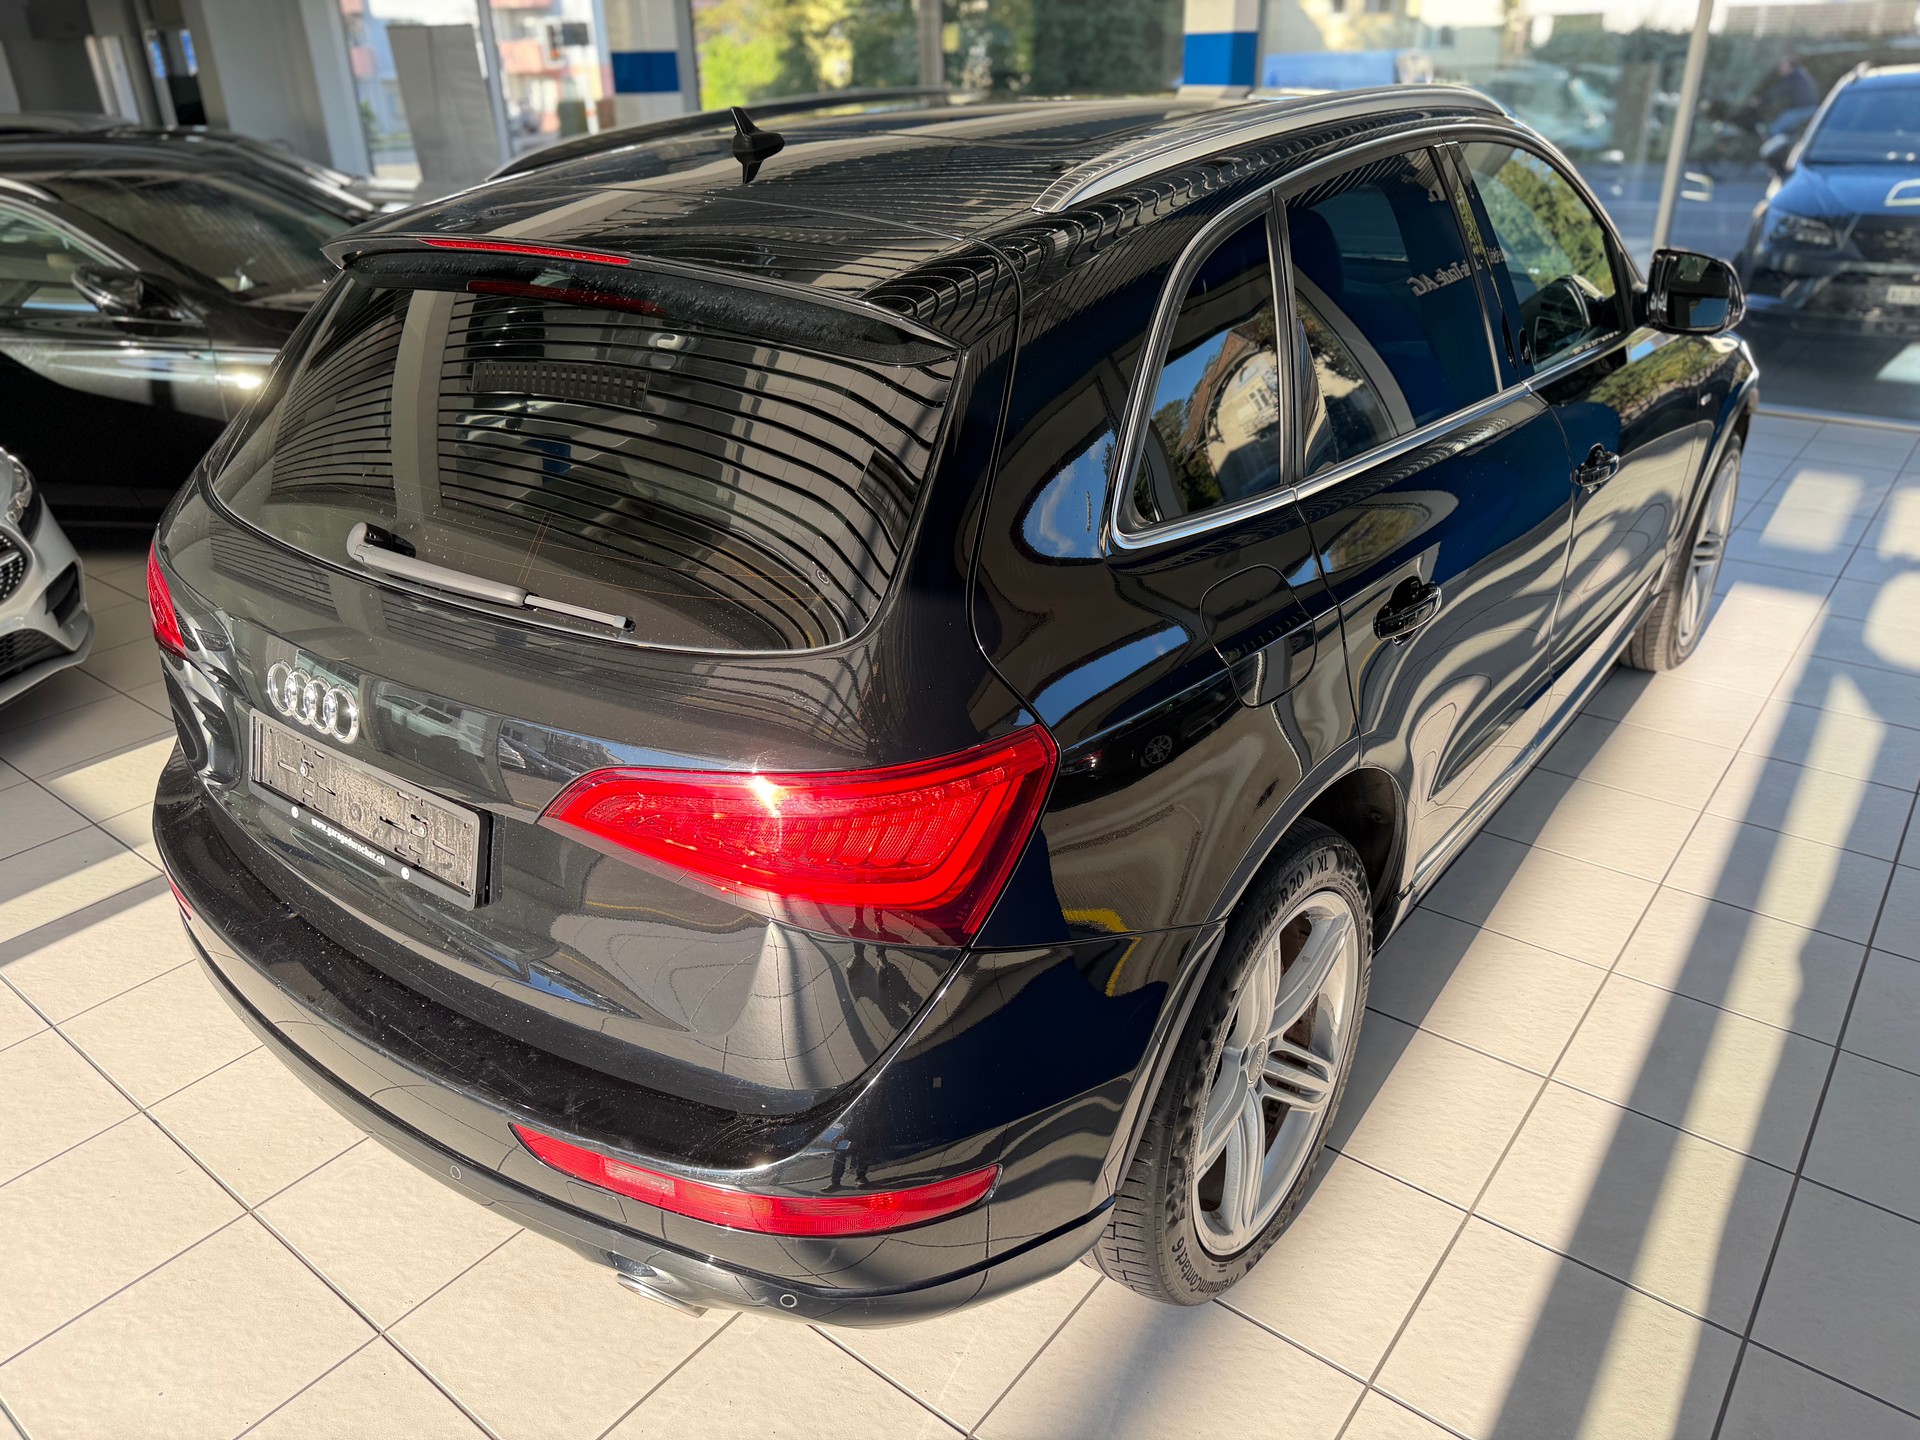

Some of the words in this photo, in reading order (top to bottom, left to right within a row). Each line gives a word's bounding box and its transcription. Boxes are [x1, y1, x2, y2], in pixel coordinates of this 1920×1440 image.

[1237, 904, 1278, 974] 255/45
[1306, 861, 1314, 880] Y
[1317, 850, 1329, 875] XL
[1171, 1236, 1185, 1253] 6
